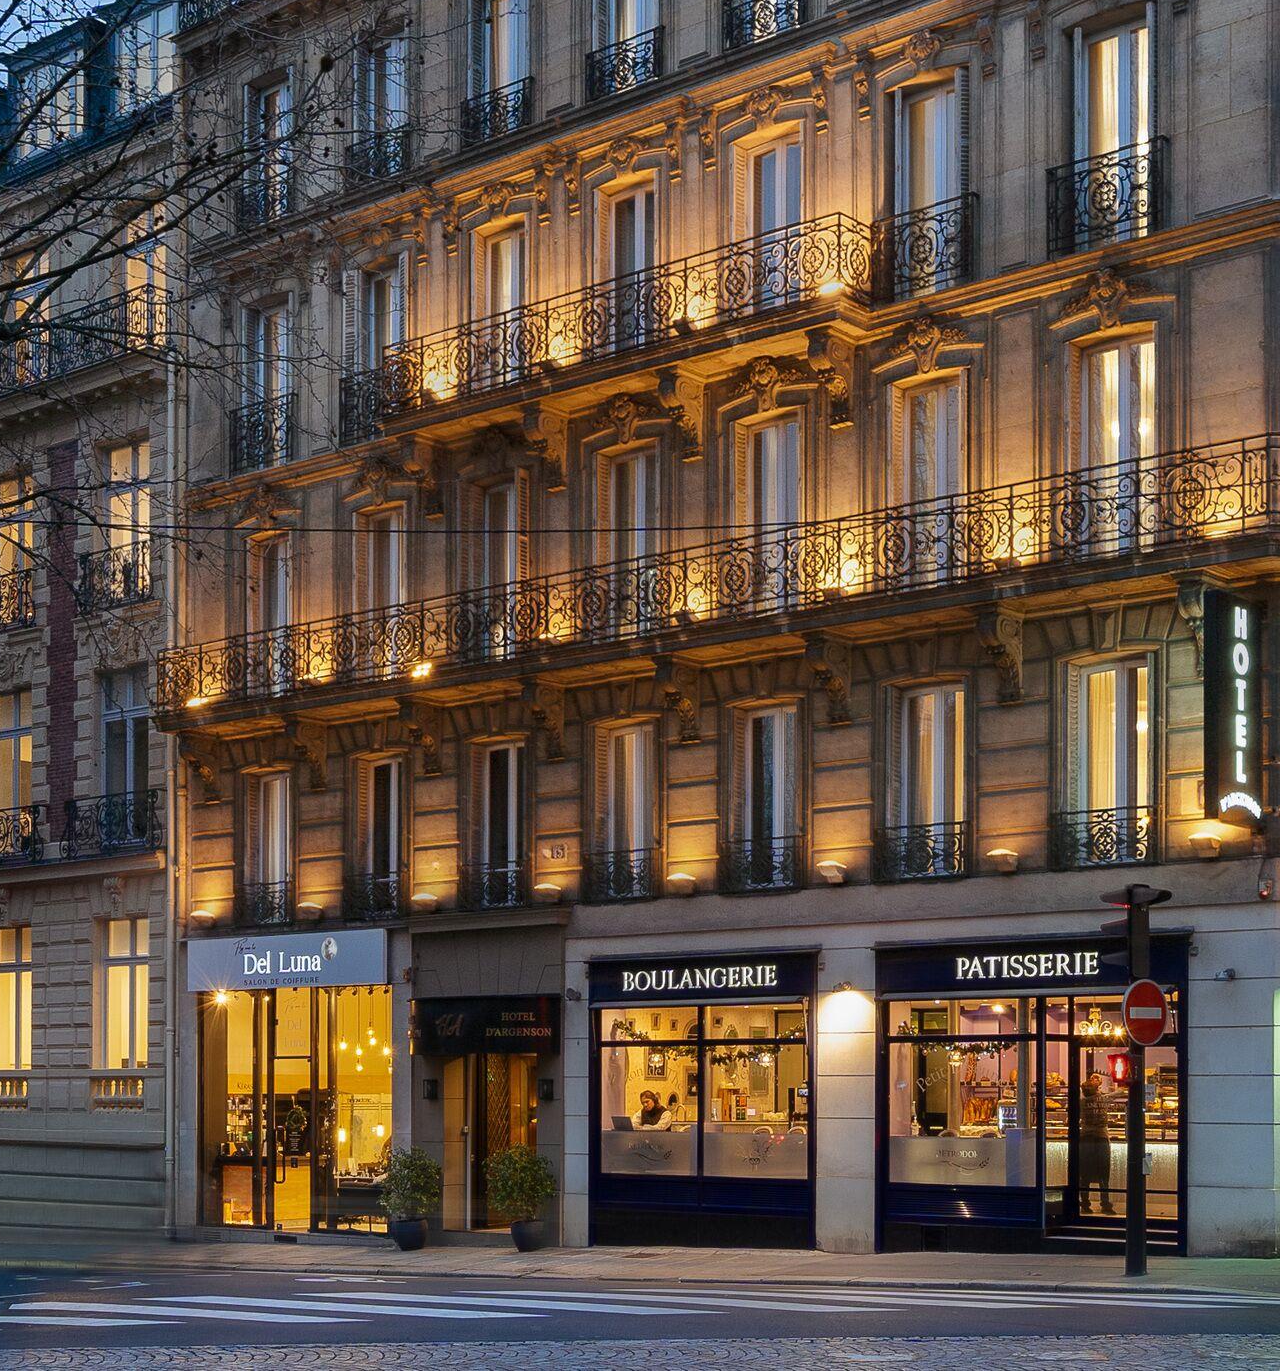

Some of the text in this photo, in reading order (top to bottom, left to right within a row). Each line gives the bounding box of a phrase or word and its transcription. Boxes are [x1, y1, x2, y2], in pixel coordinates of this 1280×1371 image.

[1231, 605, 1250, 784] HOTEL
[243, 950, 322, 975] Del Luna
[954, 950, 1100, 980] PATISSERIE
[243, 979, 268, 987] SALON
[282, 976, 320, 985] COIFFURE
[621, 964, 779, 992] BOULANGERIE
[501, 1012, 536, 1022] HOTEL
[485, 1027, 552, 1037] D'ARGENSON
